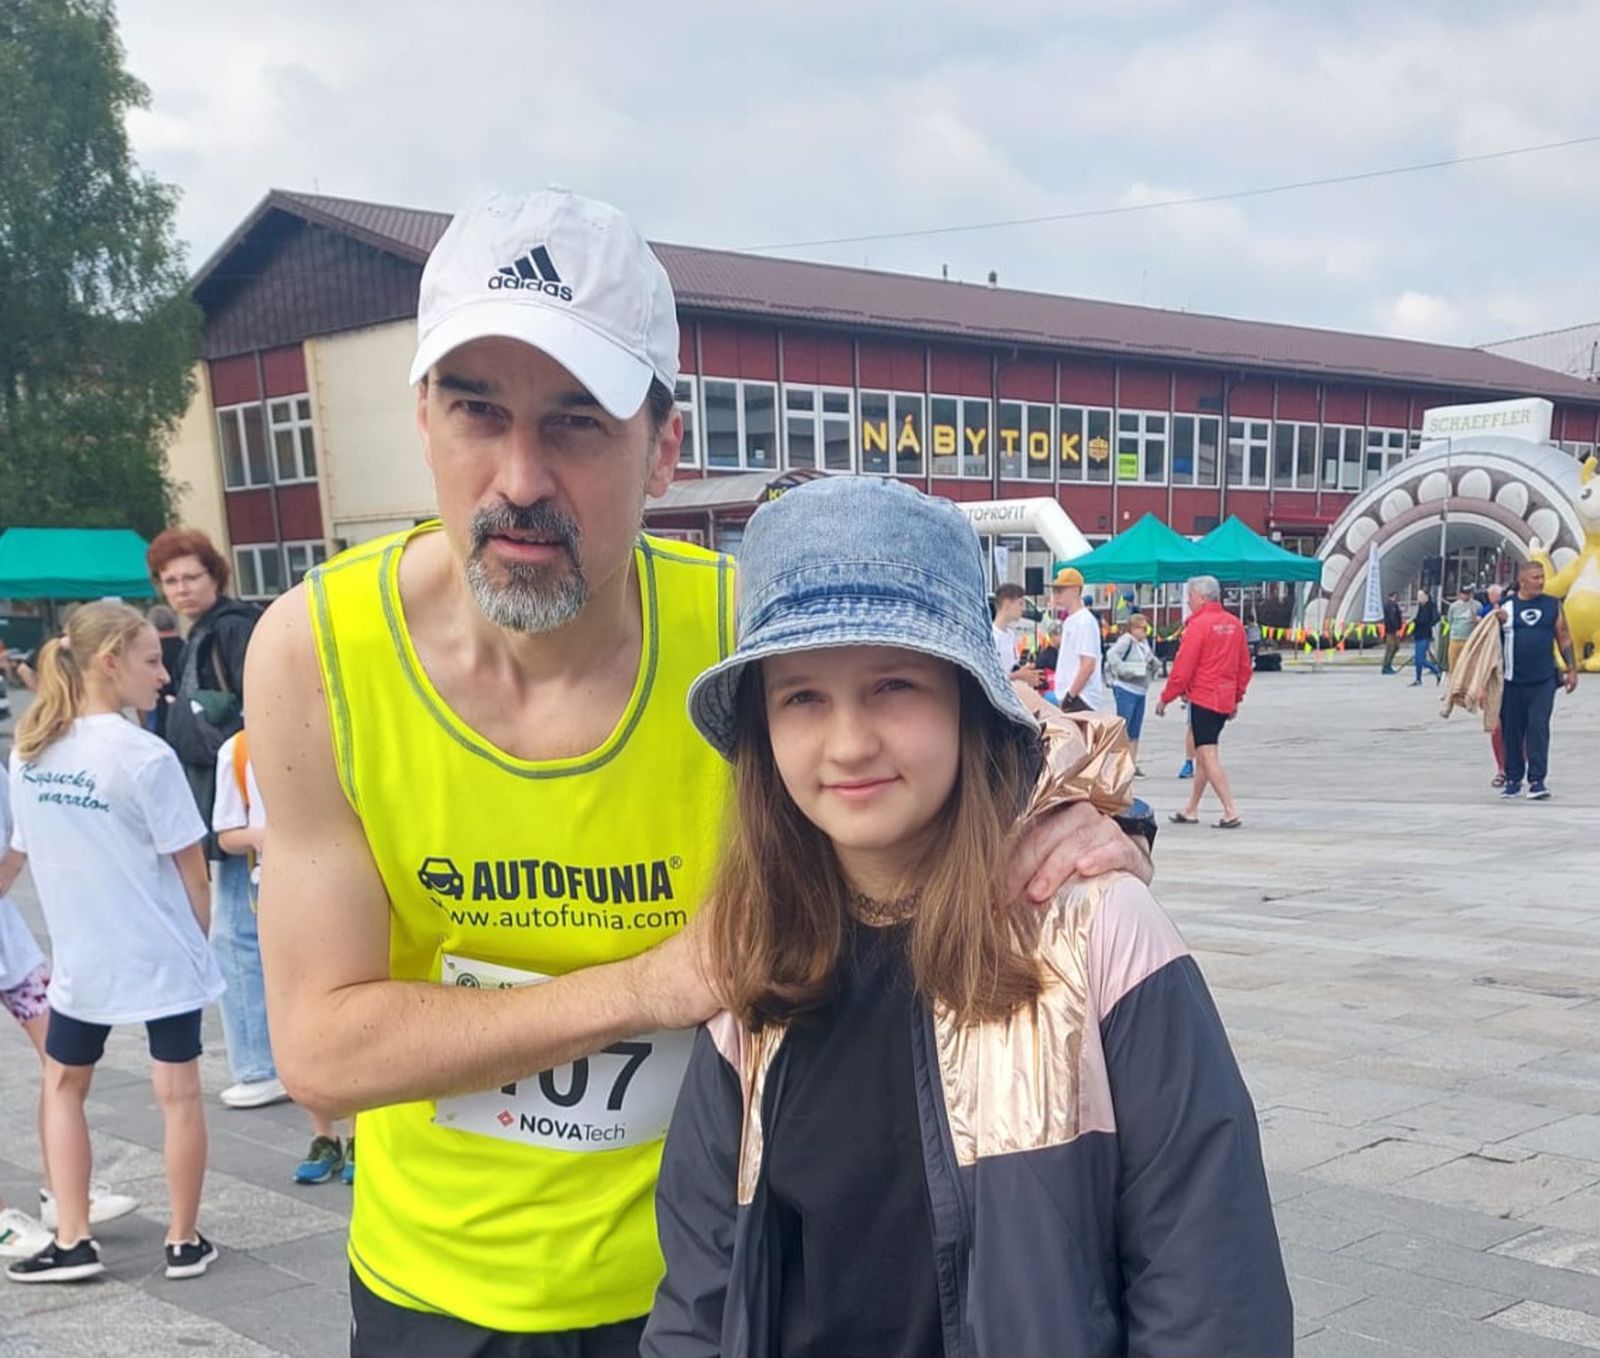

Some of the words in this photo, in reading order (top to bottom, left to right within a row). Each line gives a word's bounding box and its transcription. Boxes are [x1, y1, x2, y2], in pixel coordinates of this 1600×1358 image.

[487, 275, 574, 302] adidas
[1429, 409, 1531, 432] SCHAEFFLER
[863, 414, 1081, 461] NÁBYTOK
[501, 1042, 653, 1111] 07
[519, 1113, 626, 1142] NOVATech
